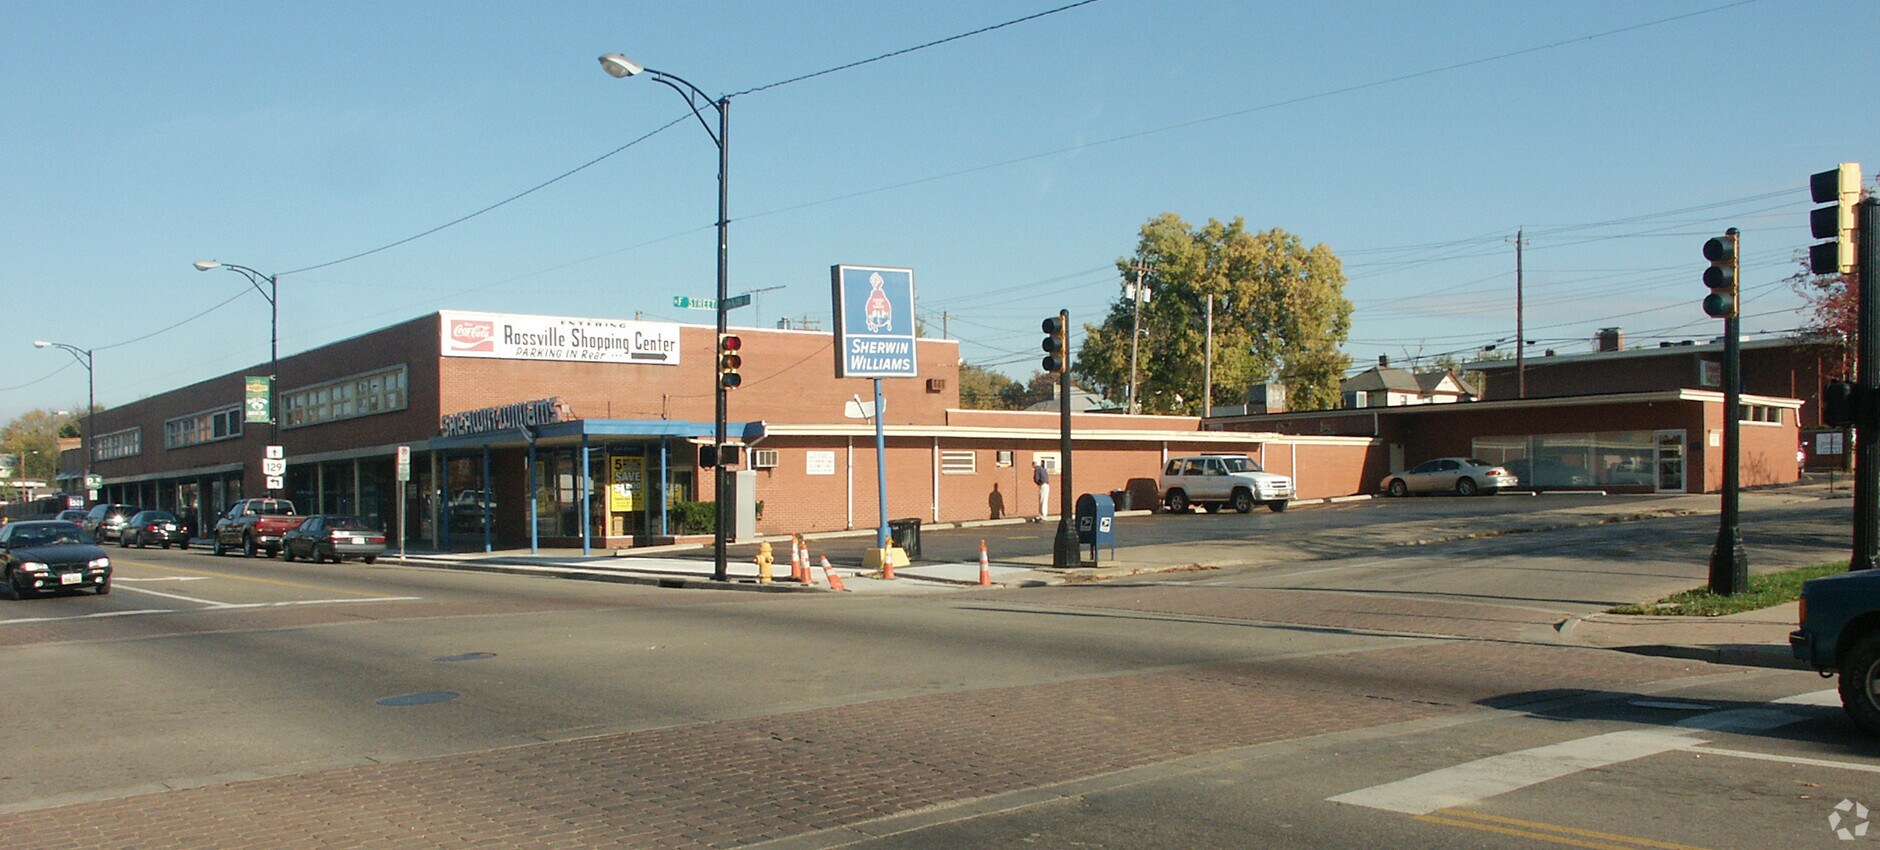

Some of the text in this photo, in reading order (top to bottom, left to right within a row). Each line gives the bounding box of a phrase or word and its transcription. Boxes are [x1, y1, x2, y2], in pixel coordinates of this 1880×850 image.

[689, 299, 718, 309] STREET
[561, 320, 626, 328] ENTERING
[453, 324, 490, 338] Coca-Cola
[504, 324, 676, 354] Rossville Shopping Center
[851, 338, 909, 354] SHERWIN
[515, 347, 563, 358] PARKING
[565, 349, 578, 359] IN
[850, 355, 911, 370] WILLIAMS
[266, 463, 282, 472] 129
[614, 458, 623, 470] 5
[615, 471, 641, 481] SAVE
